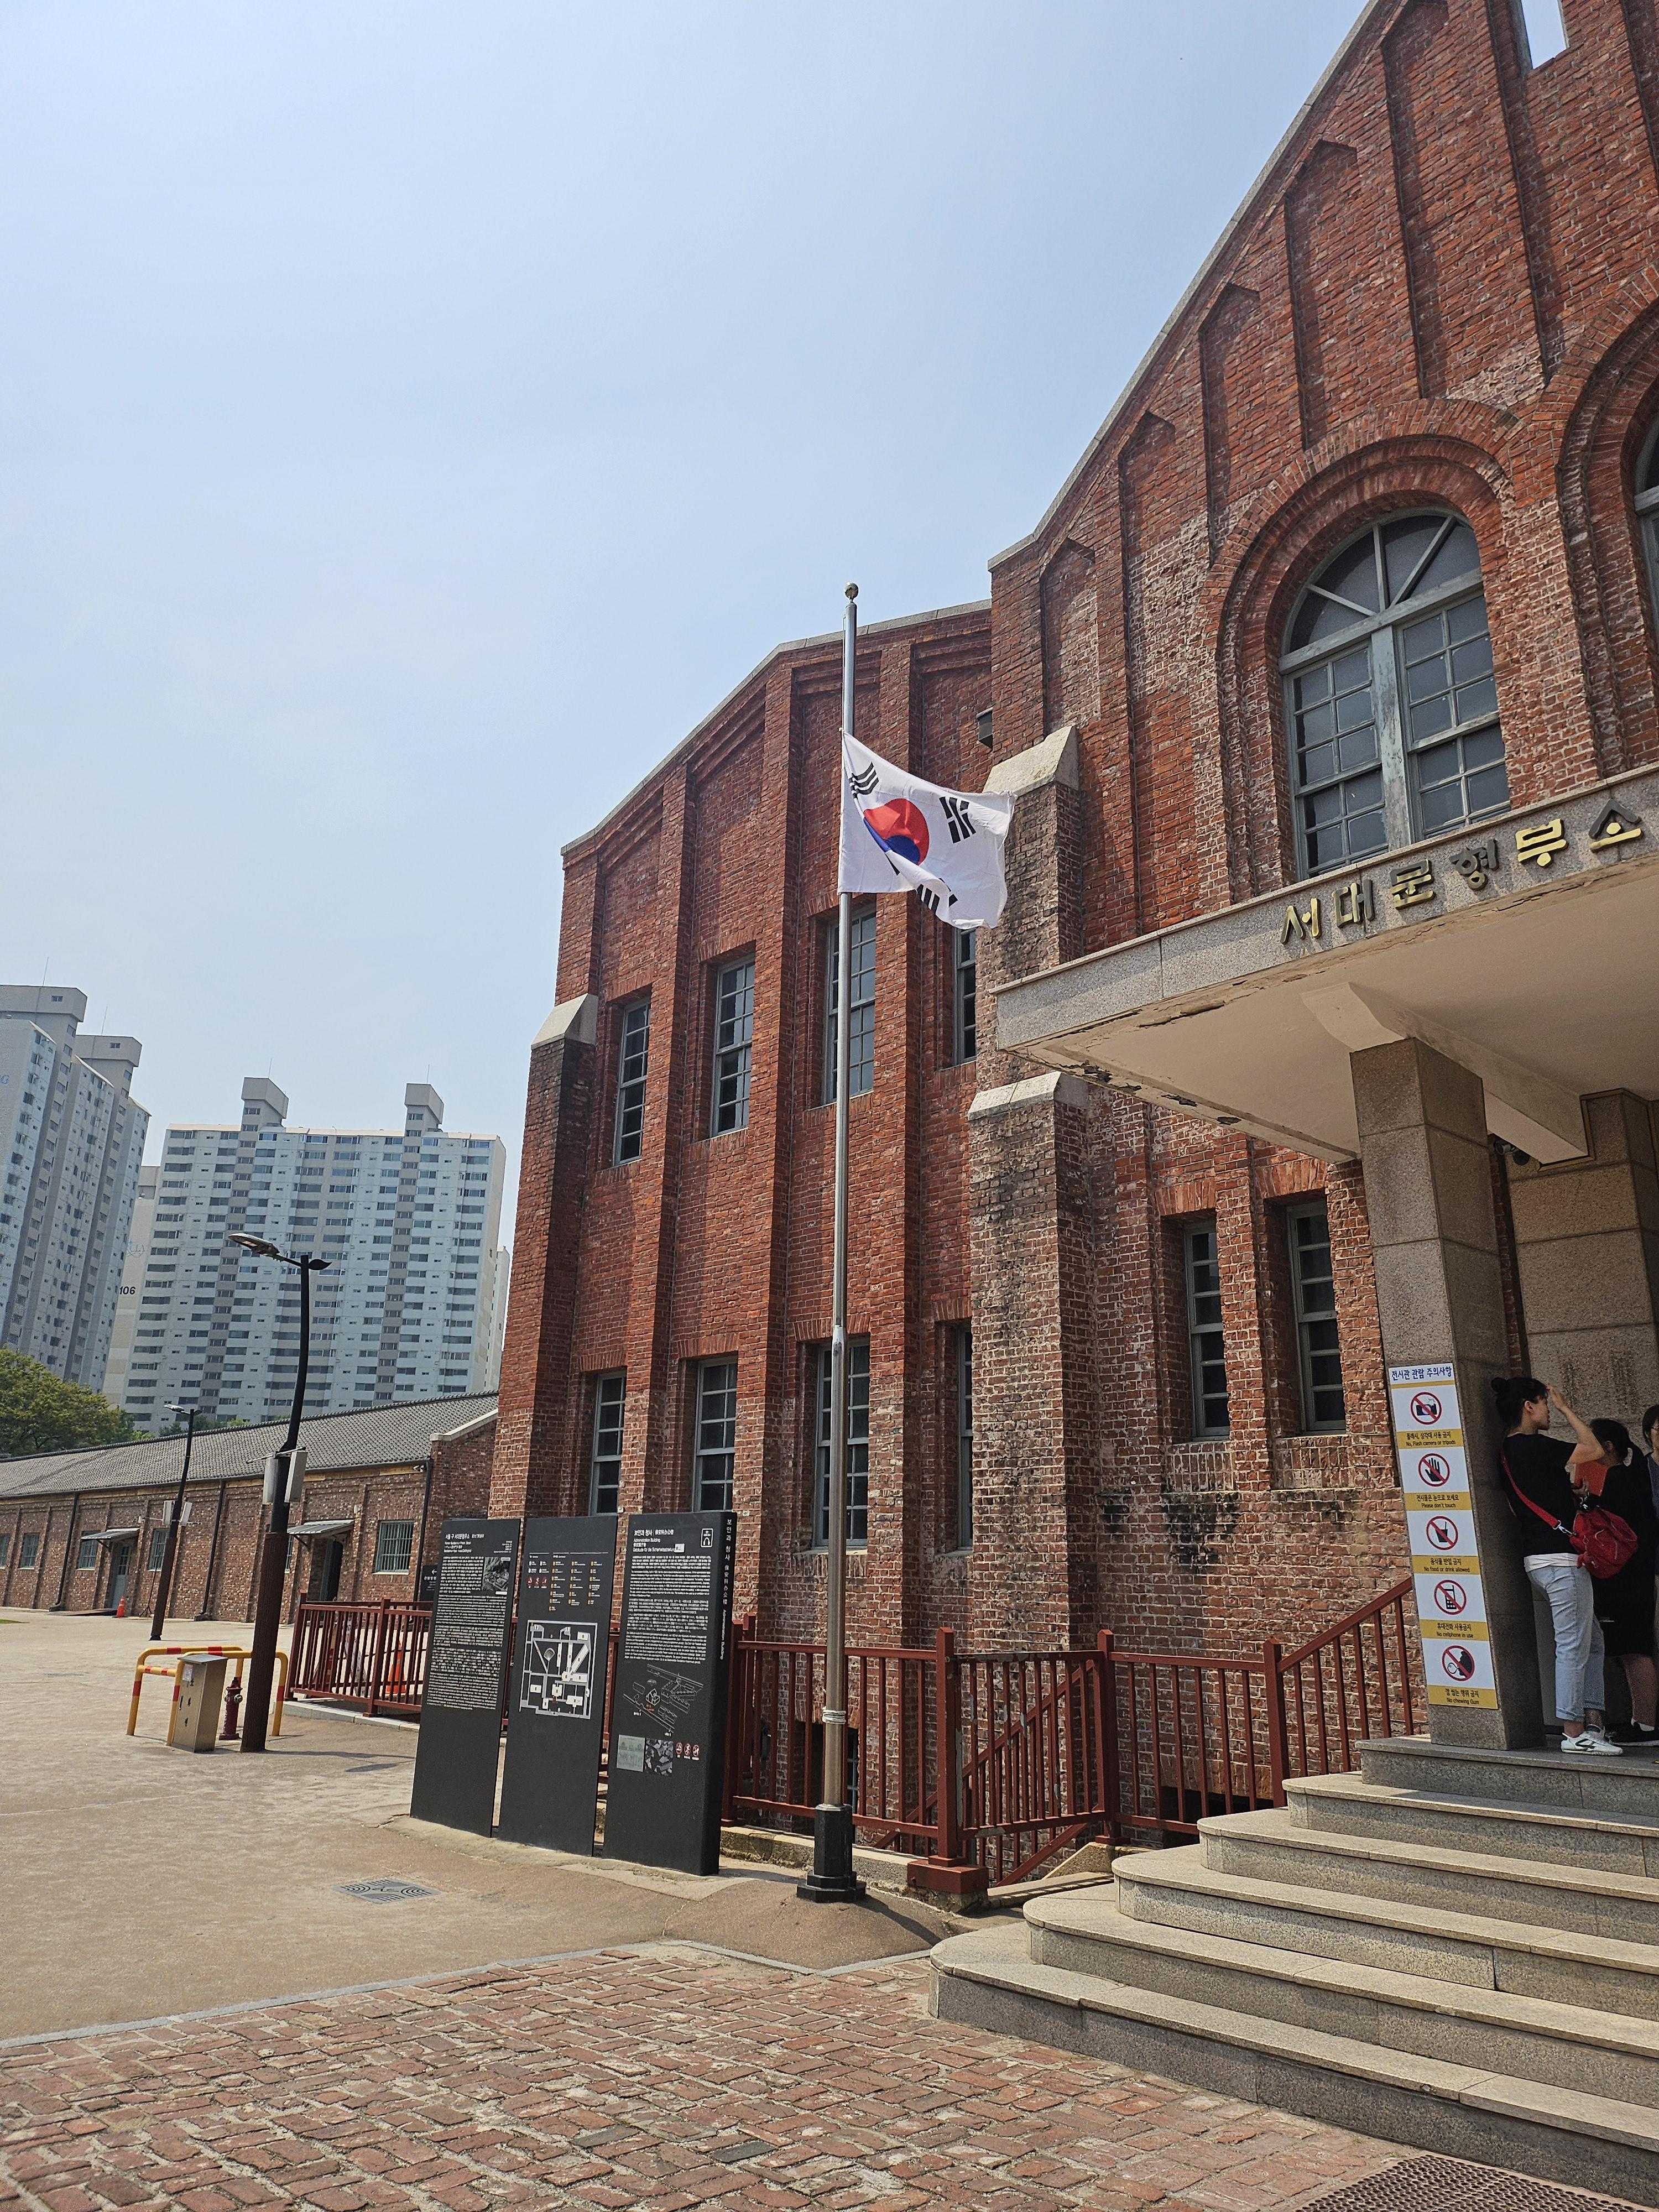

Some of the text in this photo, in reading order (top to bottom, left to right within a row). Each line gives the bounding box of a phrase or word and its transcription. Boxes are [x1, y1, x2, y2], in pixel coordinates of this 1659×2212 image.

[1280, 797, 1642, 943] 서대문형무소
[119, 1286, 136, 1295] 106
[1391, 1366, 1452, 1381] 전시관 관람 주의사항
[724, 1546, 731, 1561] 청사
[1470, 1690, 1479, 1698] 금지
